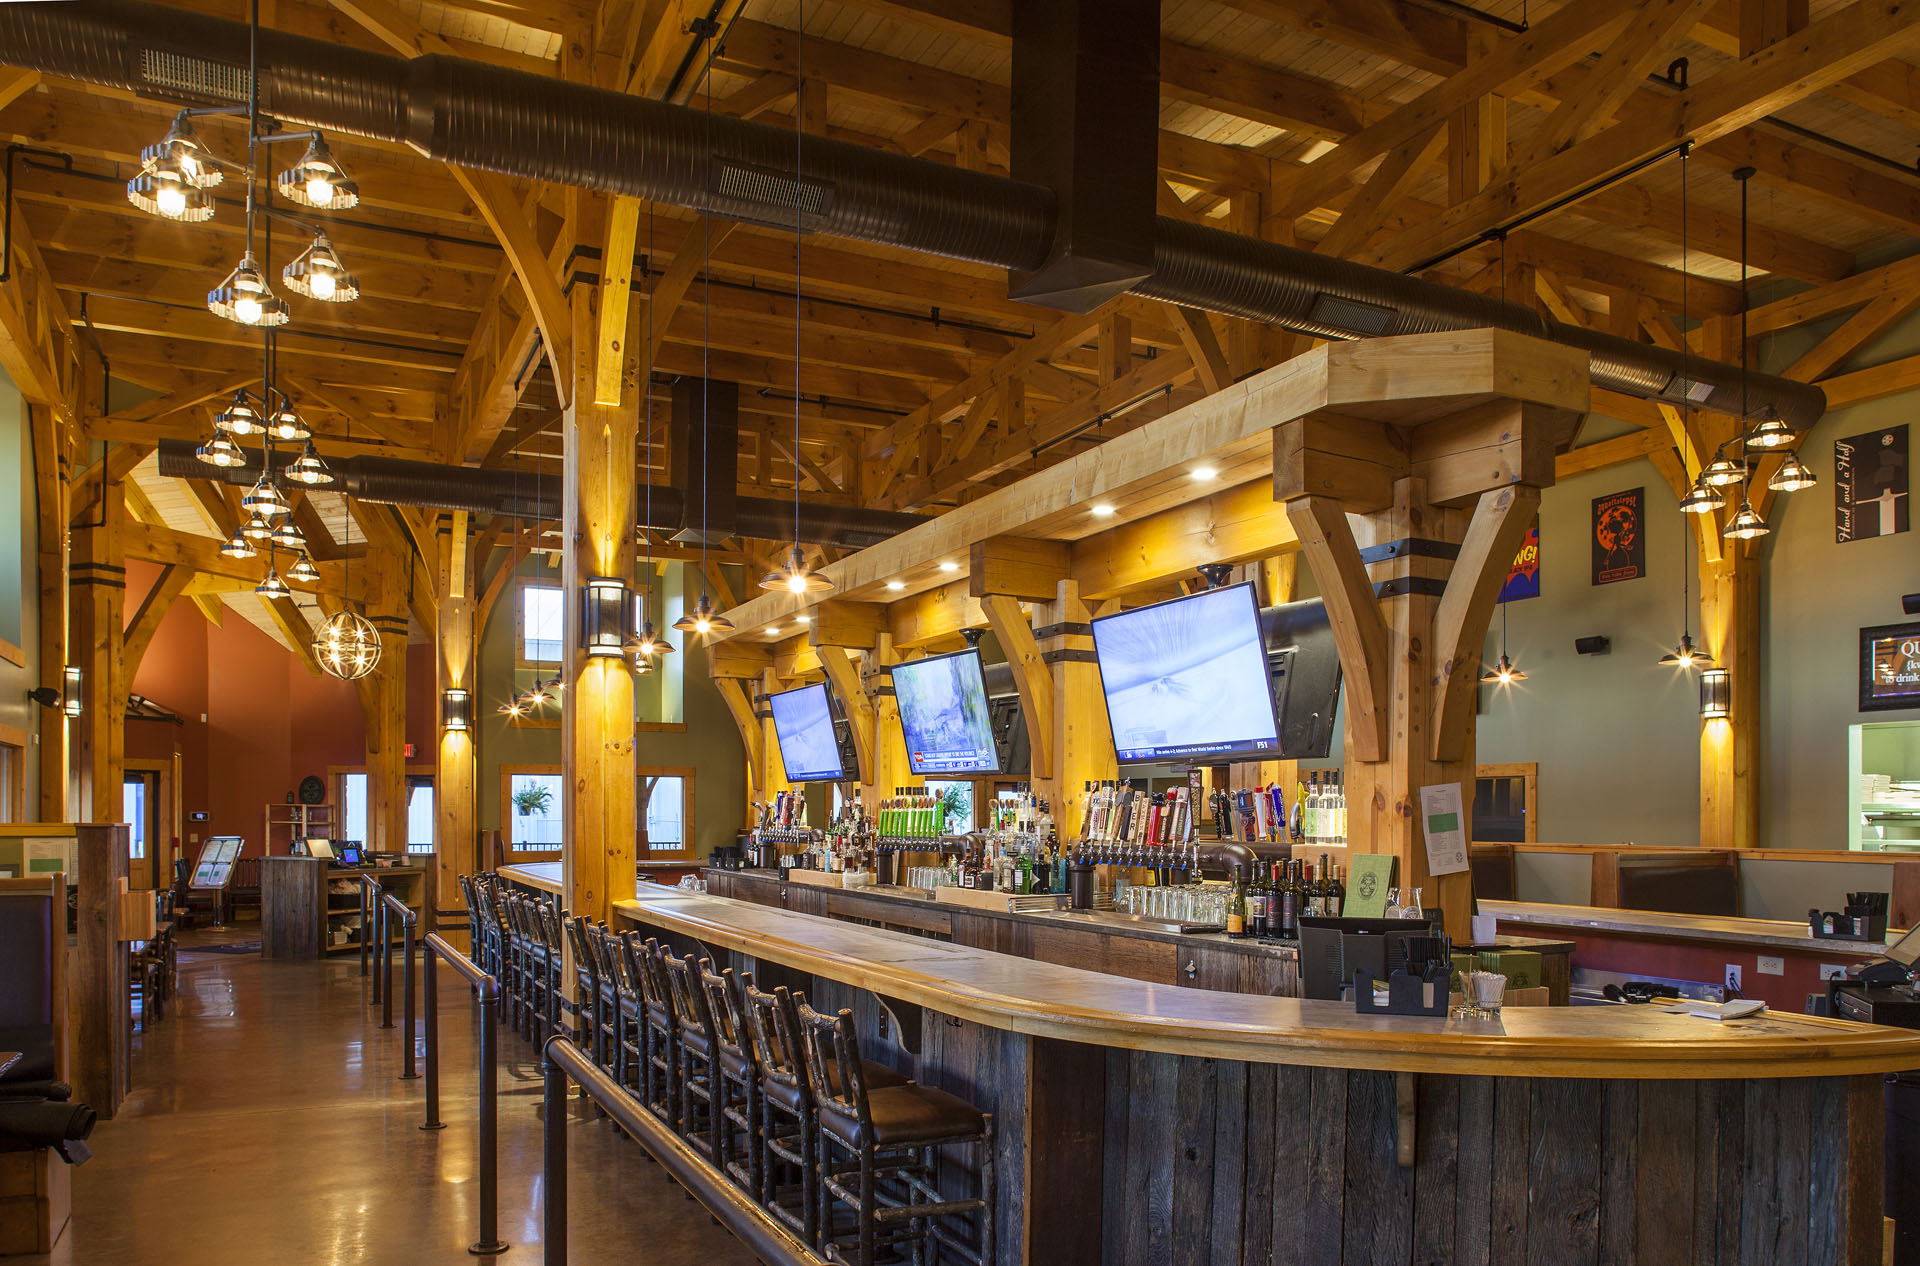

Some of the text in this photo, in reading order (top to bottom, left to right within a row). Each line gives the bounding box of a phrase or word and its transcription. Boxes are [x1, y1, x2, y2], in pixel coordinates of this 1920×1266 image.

[1836, 441, 1855, 470] Half
[1837, 482, 1851, 503] and
[1837, 506, 1851, 541] Hand
[1896, 673, 1920, 683] drink
